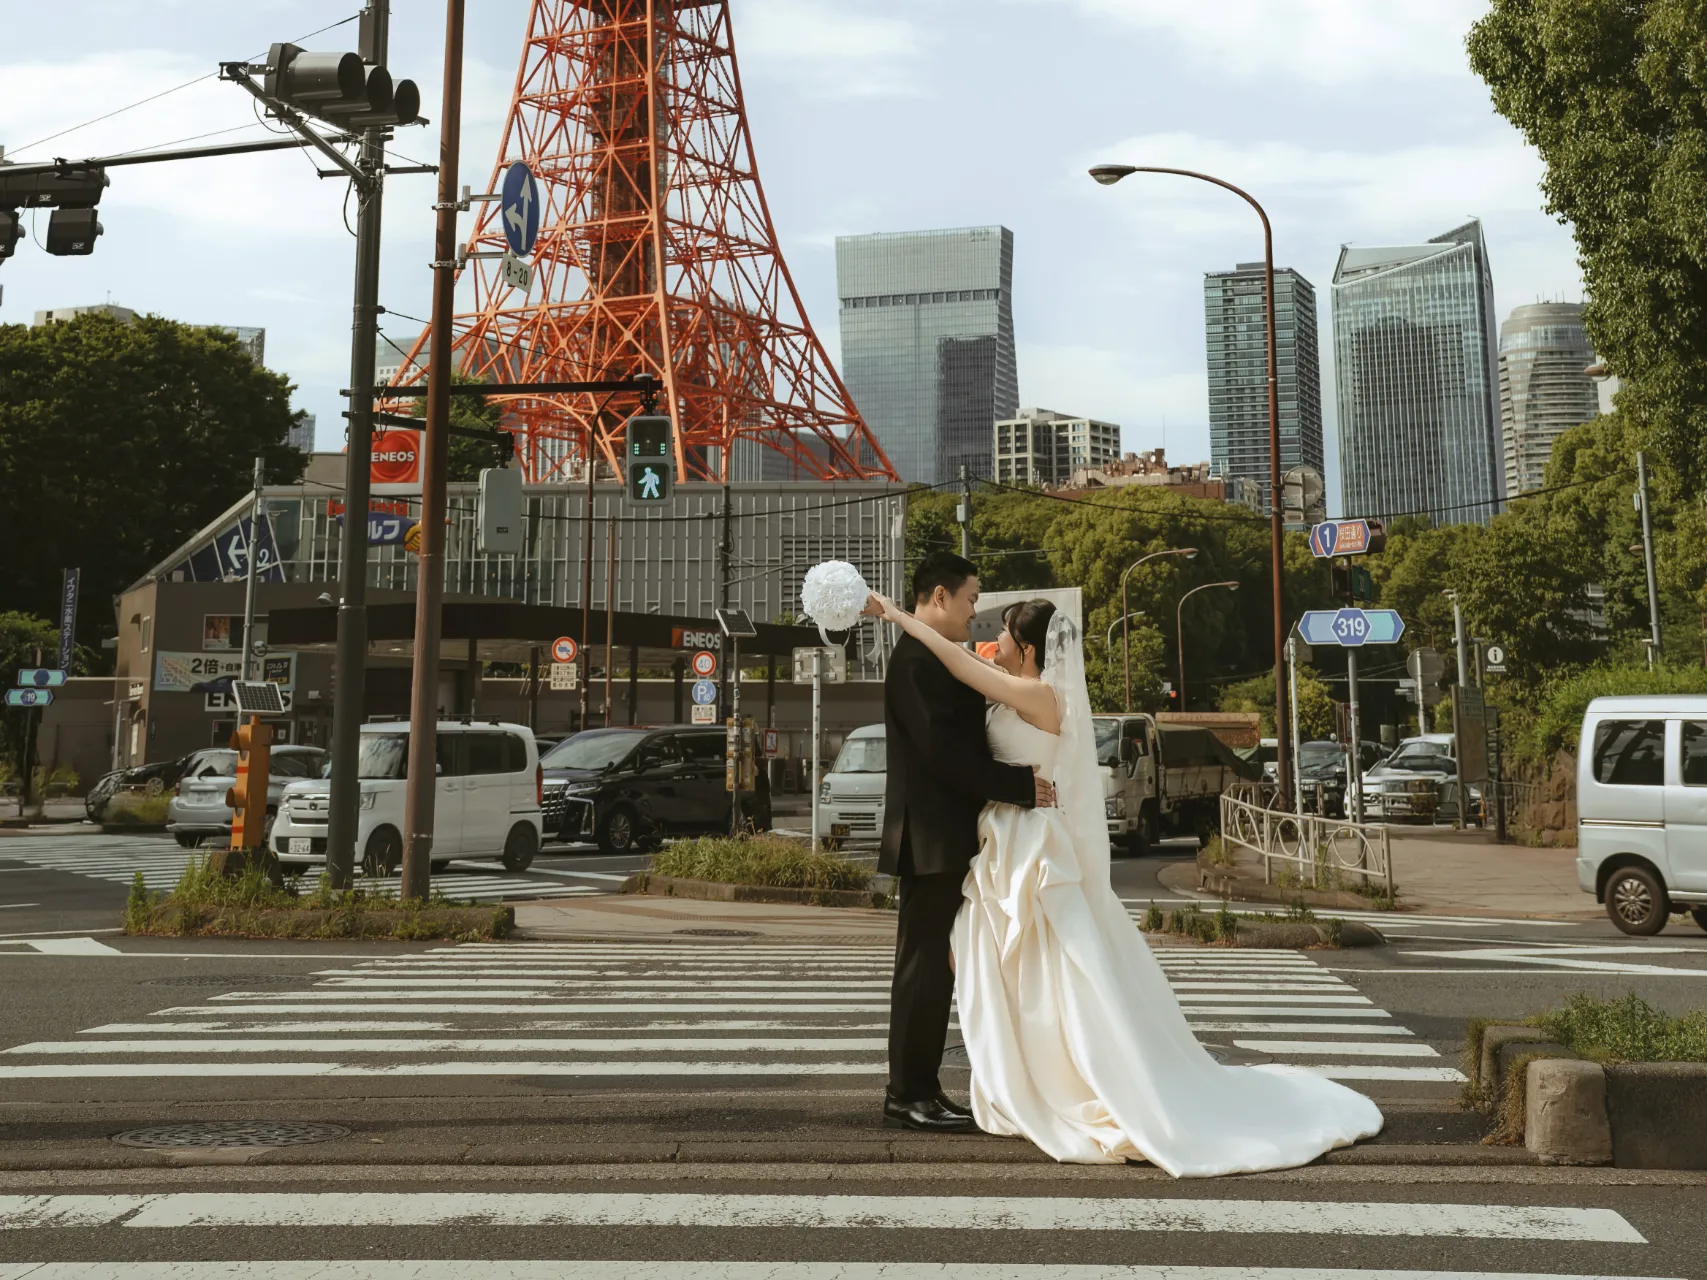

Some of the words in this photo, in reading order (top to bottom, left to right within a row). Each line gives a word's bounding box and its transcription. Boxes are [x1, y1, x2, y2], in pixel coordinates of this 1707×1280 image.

[371, 451, 415, 462] ENEOS
[367, 520, 400, 540] ルフ
[1323, 527, 1331, 548] 1
[1338, 617, 1365, 637] 319
[683, 631, 720, 649] ENEOS
[698, 658, 711, 669] 40
[23, 692, 36, 702] 19
[207, 691, 291, 707] ENS
[697, 685, 707, 701] P
